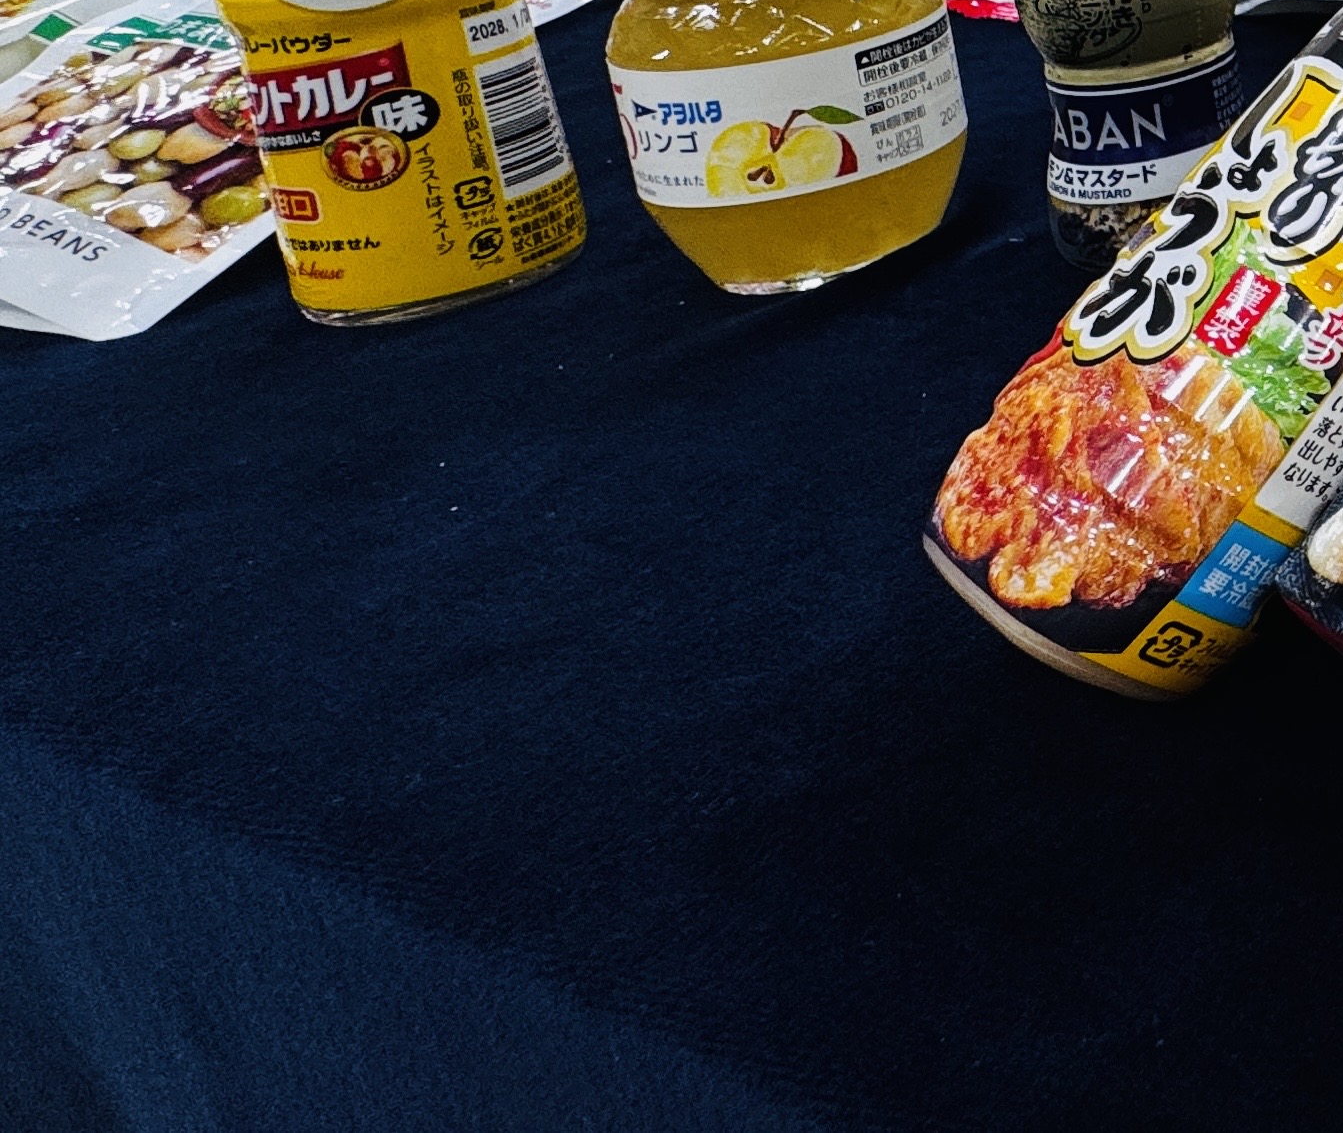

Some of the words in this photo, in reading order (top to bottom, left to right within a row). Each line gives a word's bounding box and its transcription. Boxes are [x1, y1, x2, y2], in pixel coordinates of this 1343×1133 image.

[246, 32, 351, 54] レーパウダー
[371, 94, 429, 134] 味
[658, 99, 723, 126] アヲハタ
[638, 130, 699, 154] リンゴ
[414, 142, 451, 256] イラストはイメージ
[1079, 186, 1132, 200] MUSTARD
[10, 210, 109, 265] BEANS
[1282, 463, 1333, 503] なります。
